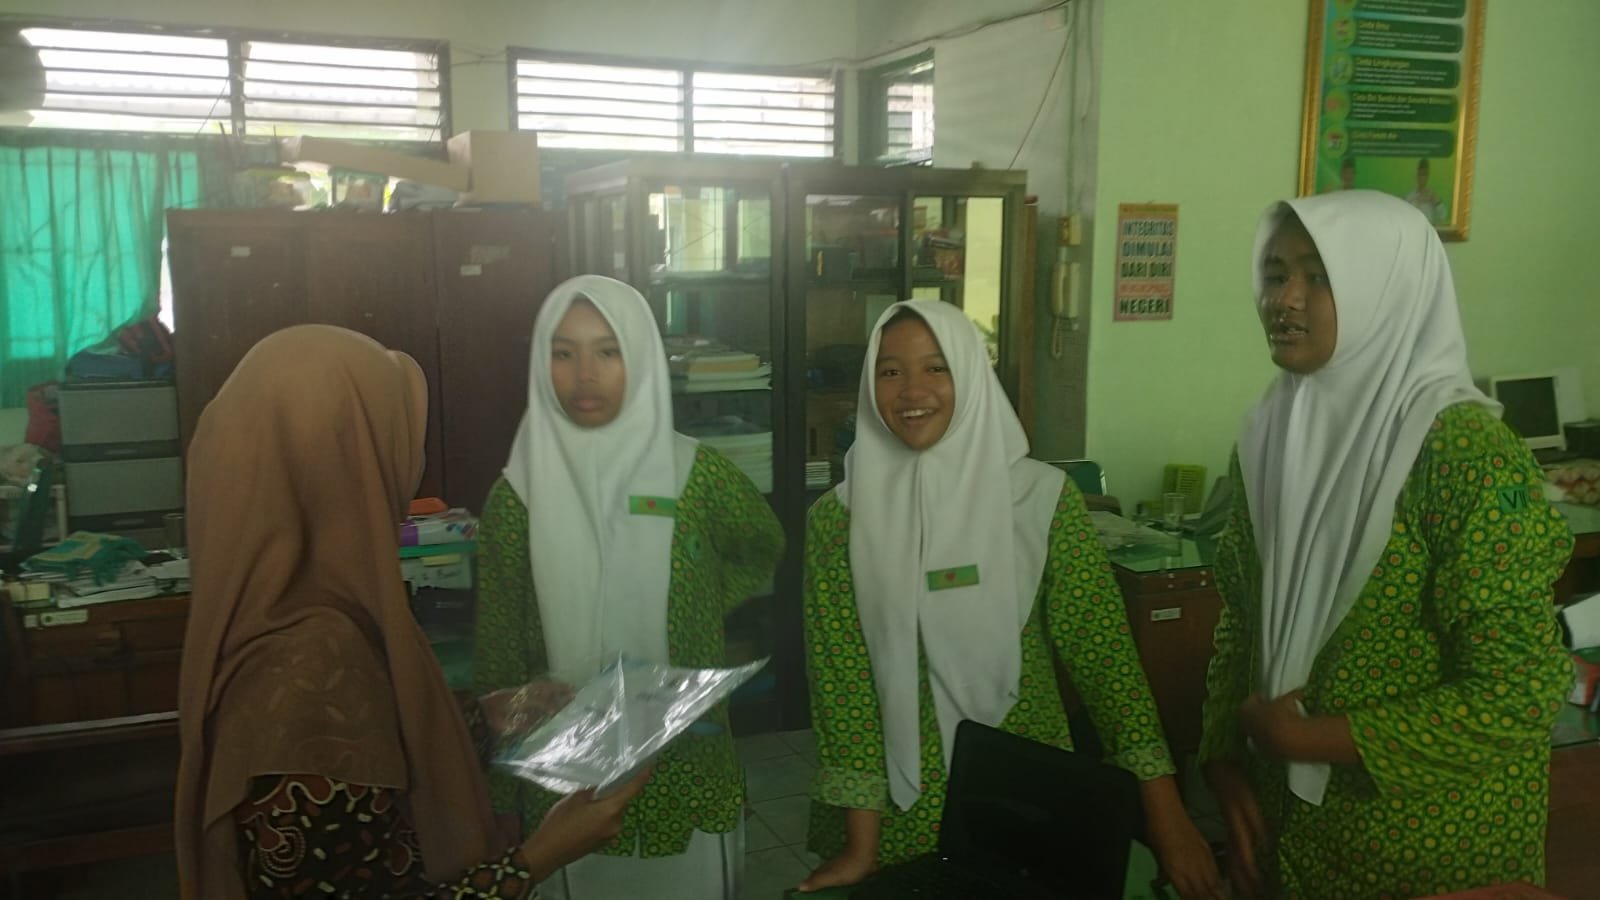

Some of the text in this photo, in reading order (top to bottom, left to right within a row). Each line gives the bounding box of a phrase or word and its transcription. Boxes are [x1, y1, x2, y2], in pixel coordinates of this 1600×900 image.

[1122, 240, 1173, 257] DIMULAI
[1121, 262, 1172, 278] DARI DIRI
[1119, 298, 1169, 314] NEGERI
